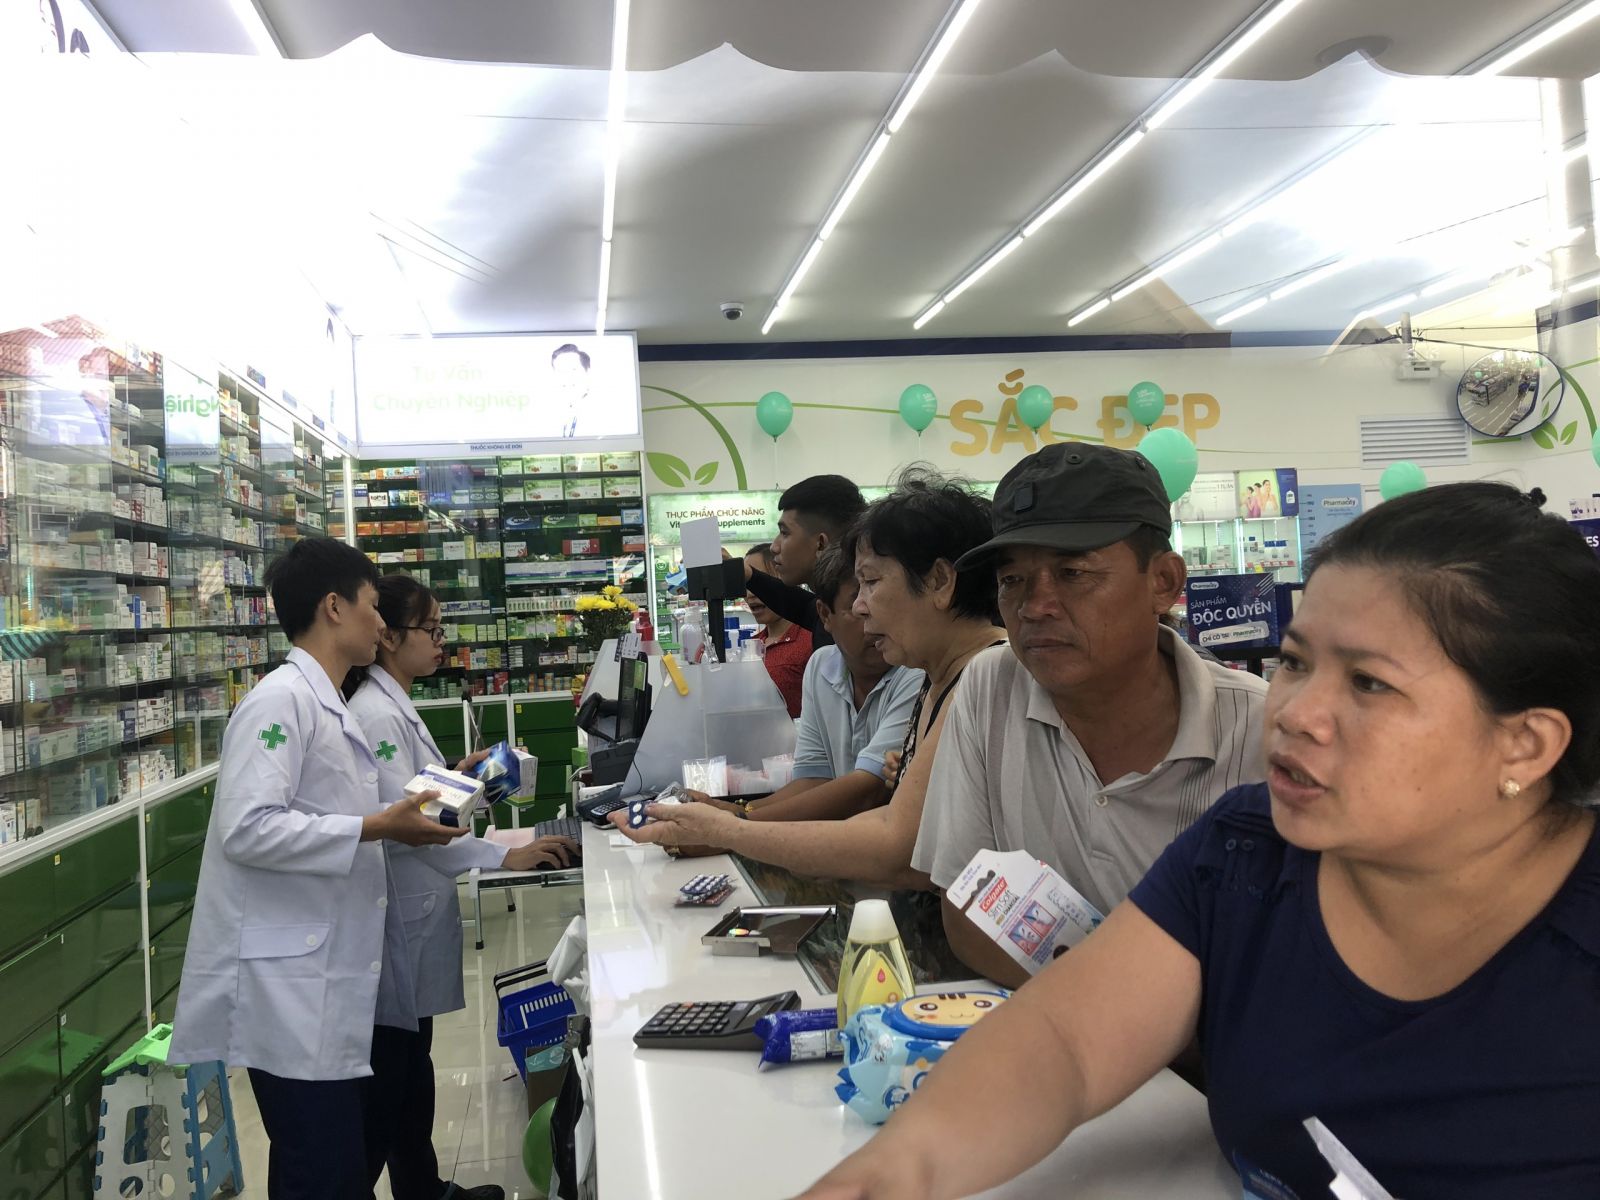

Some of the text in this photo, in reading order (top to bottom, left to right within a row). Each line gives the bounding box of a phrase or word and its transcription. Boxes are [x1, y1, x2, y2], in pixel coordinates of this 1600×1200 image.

[1323, 496, 1356, 506] Pharmacity
[666, 506, 765, 519] THỰC PHẨM CHỨC NĂNG
[718, 519, 766, 528] upplements
[1190, 595, 1227, 610] SẢN PHẨM
[1192, 608, 1223, 627] ĐỘC
[981, 880, 1006, 909] Colgate
[1003, 896, 1020, 916] CHARCOAL
